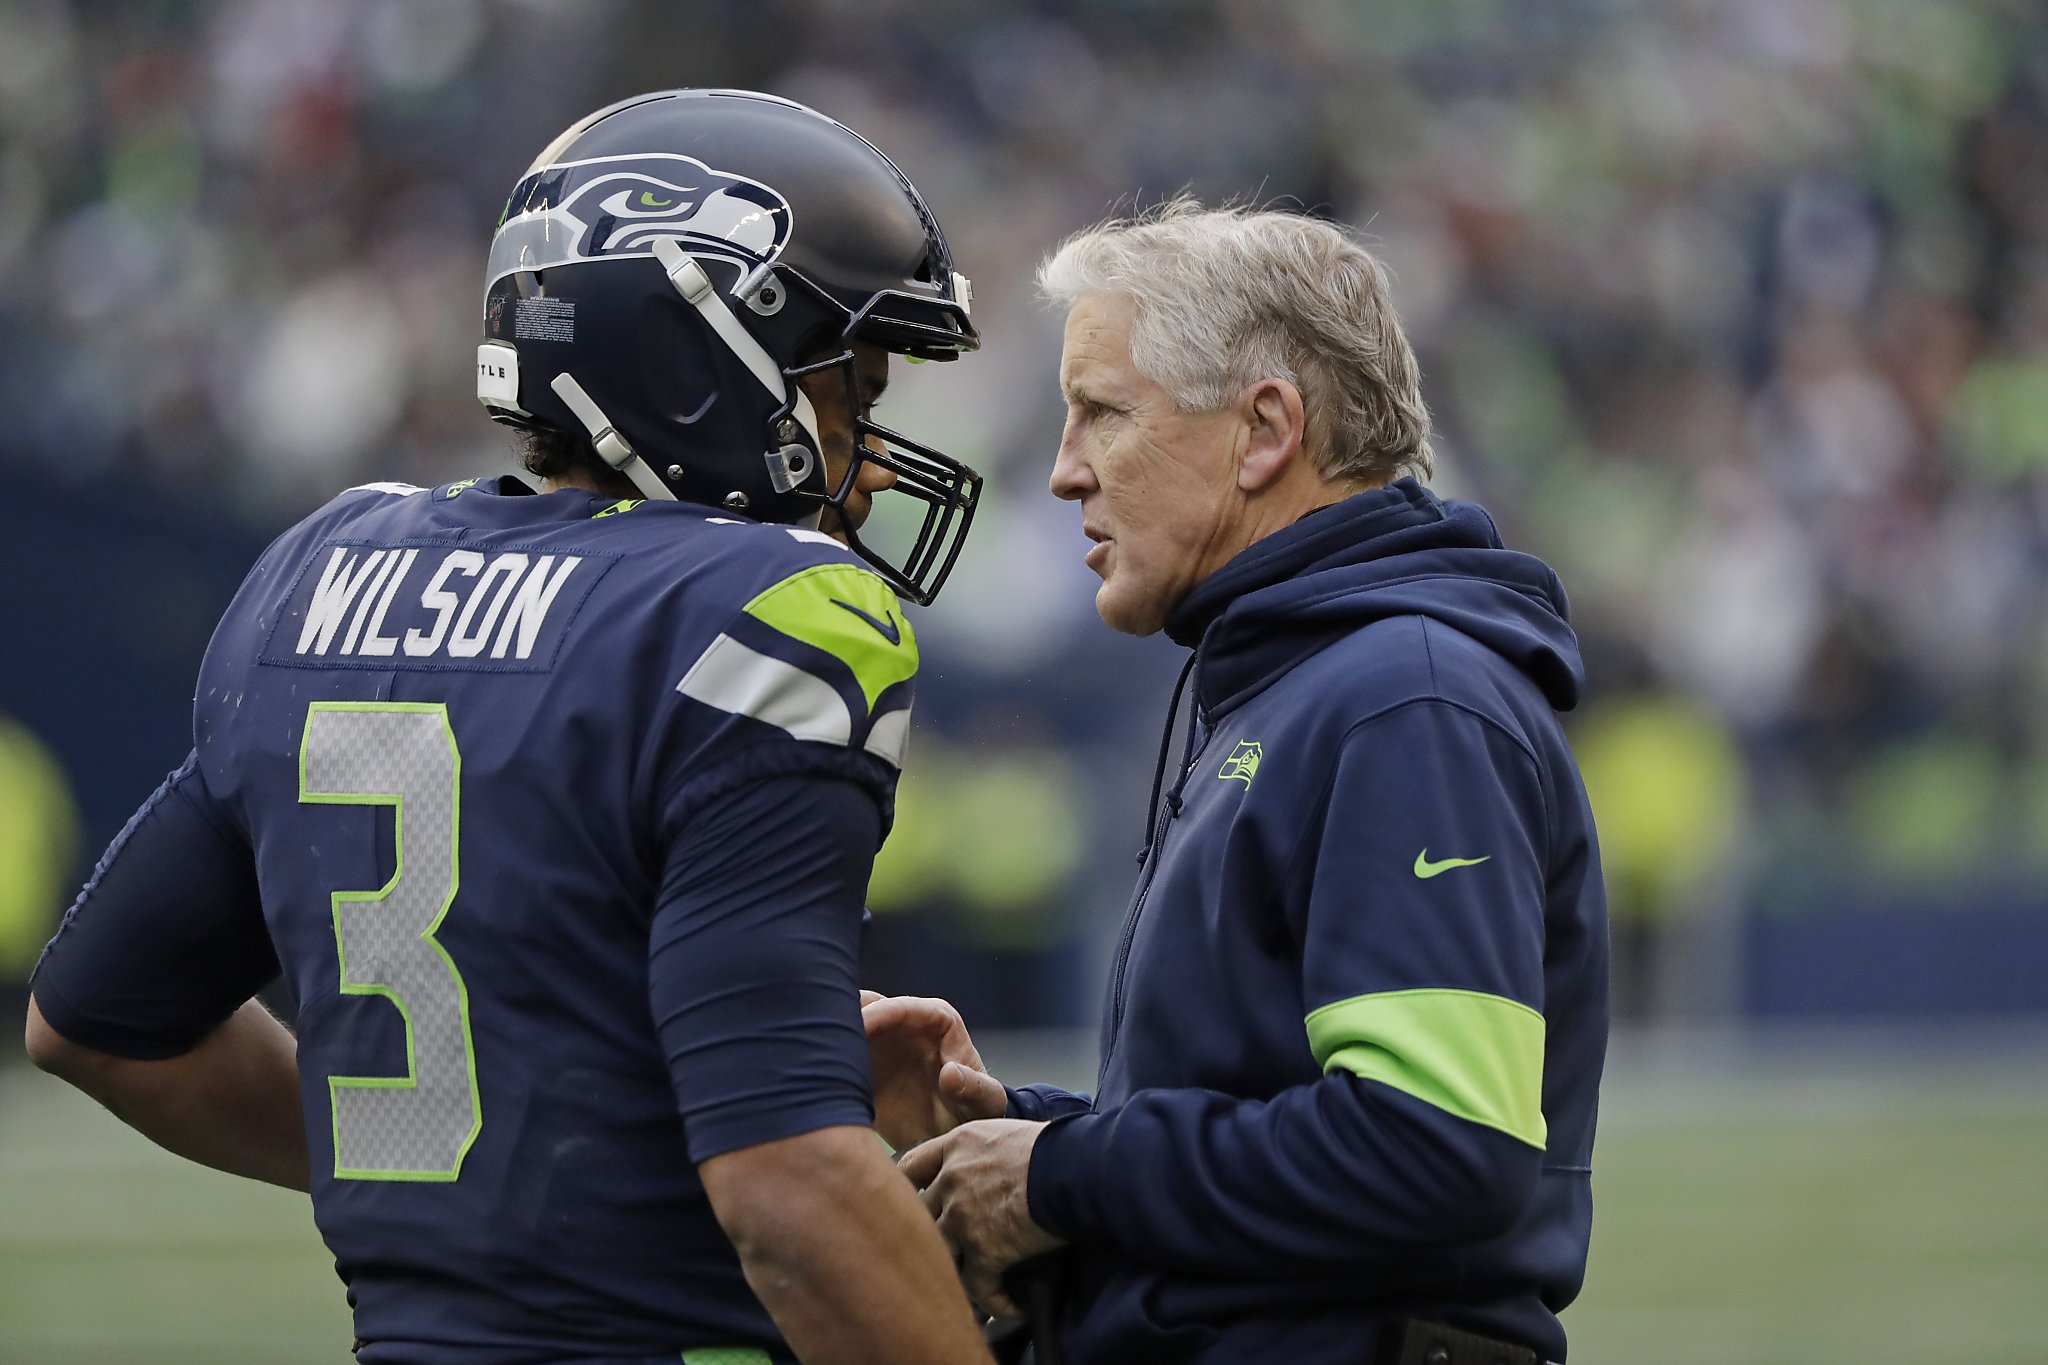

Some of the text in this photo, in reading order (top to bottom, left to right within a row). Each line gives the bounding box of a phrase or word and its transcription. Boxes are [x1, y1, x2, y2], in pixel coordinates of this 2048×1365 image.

[478, 364, 505, 379] TLE
[295, 547, 583, 659] WILSON
[298, 702, 482, 1182] 3
